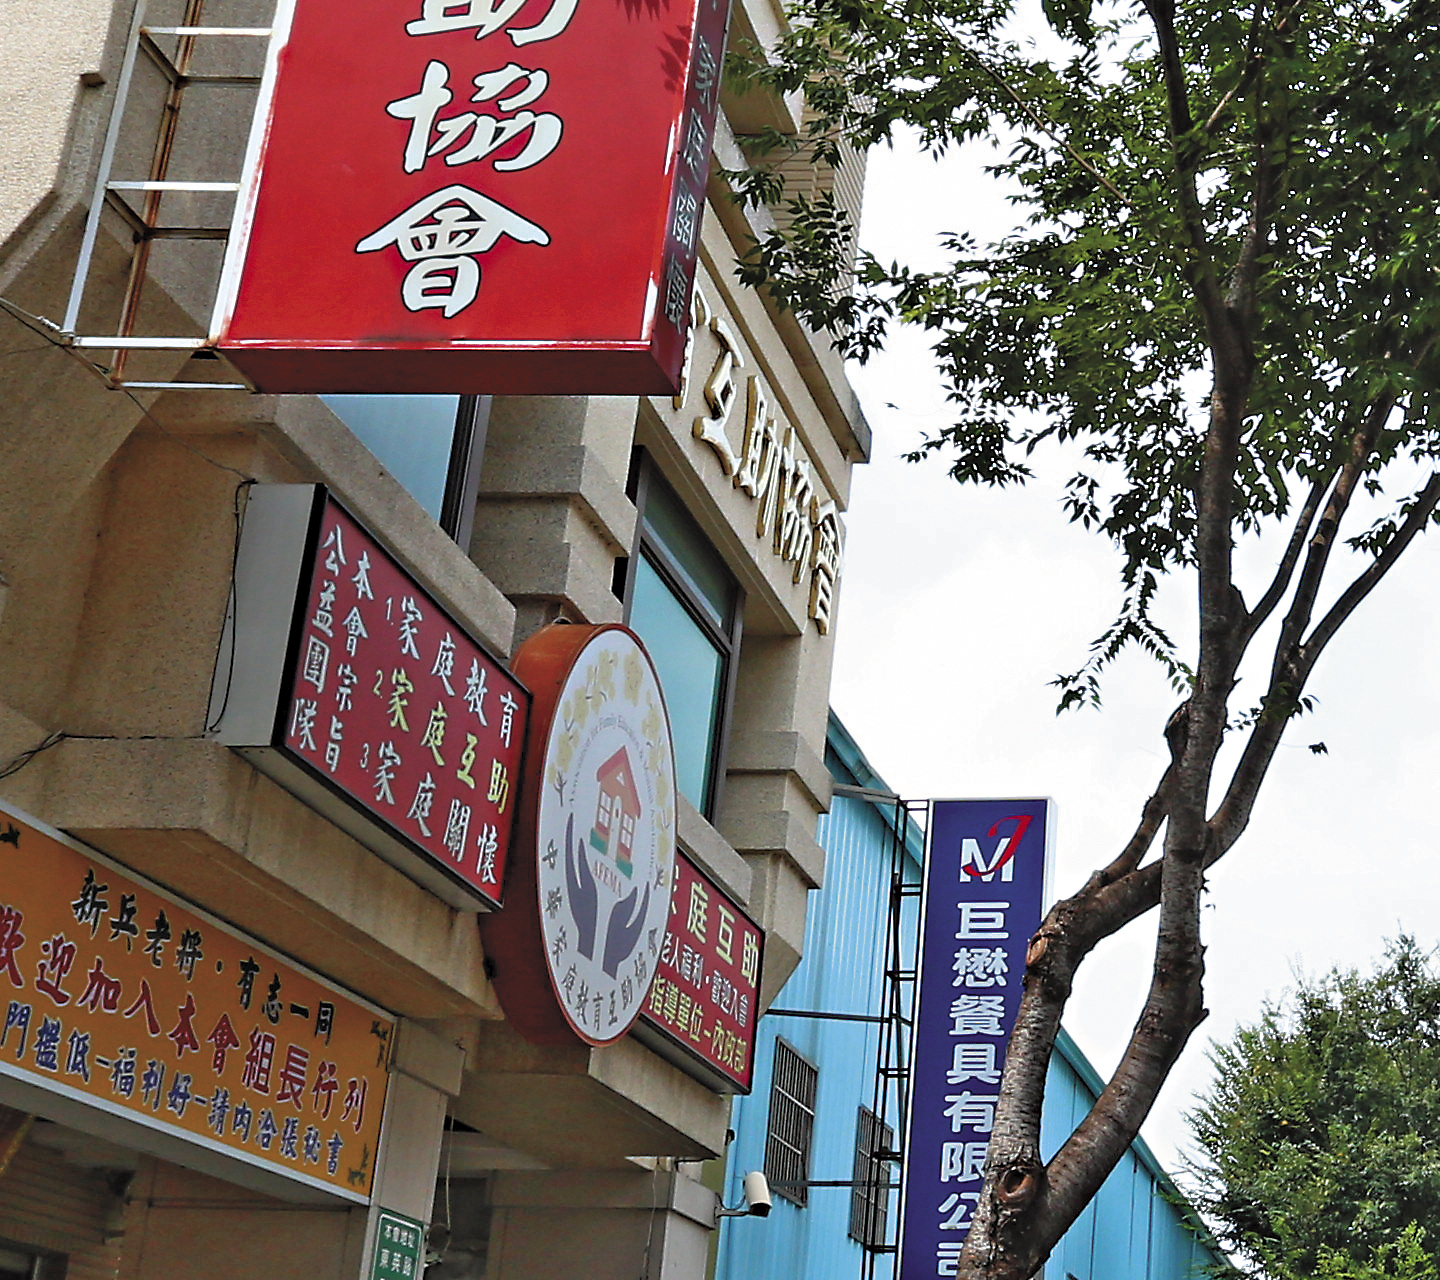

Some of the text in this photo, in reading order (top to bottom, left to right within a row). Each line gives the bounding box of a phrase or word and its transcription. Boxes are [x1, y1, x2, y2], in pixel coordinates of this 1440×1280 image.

[291, 525, 345, 753] 公益團隊
[326, 551, 374, 773] 本會宗旨
